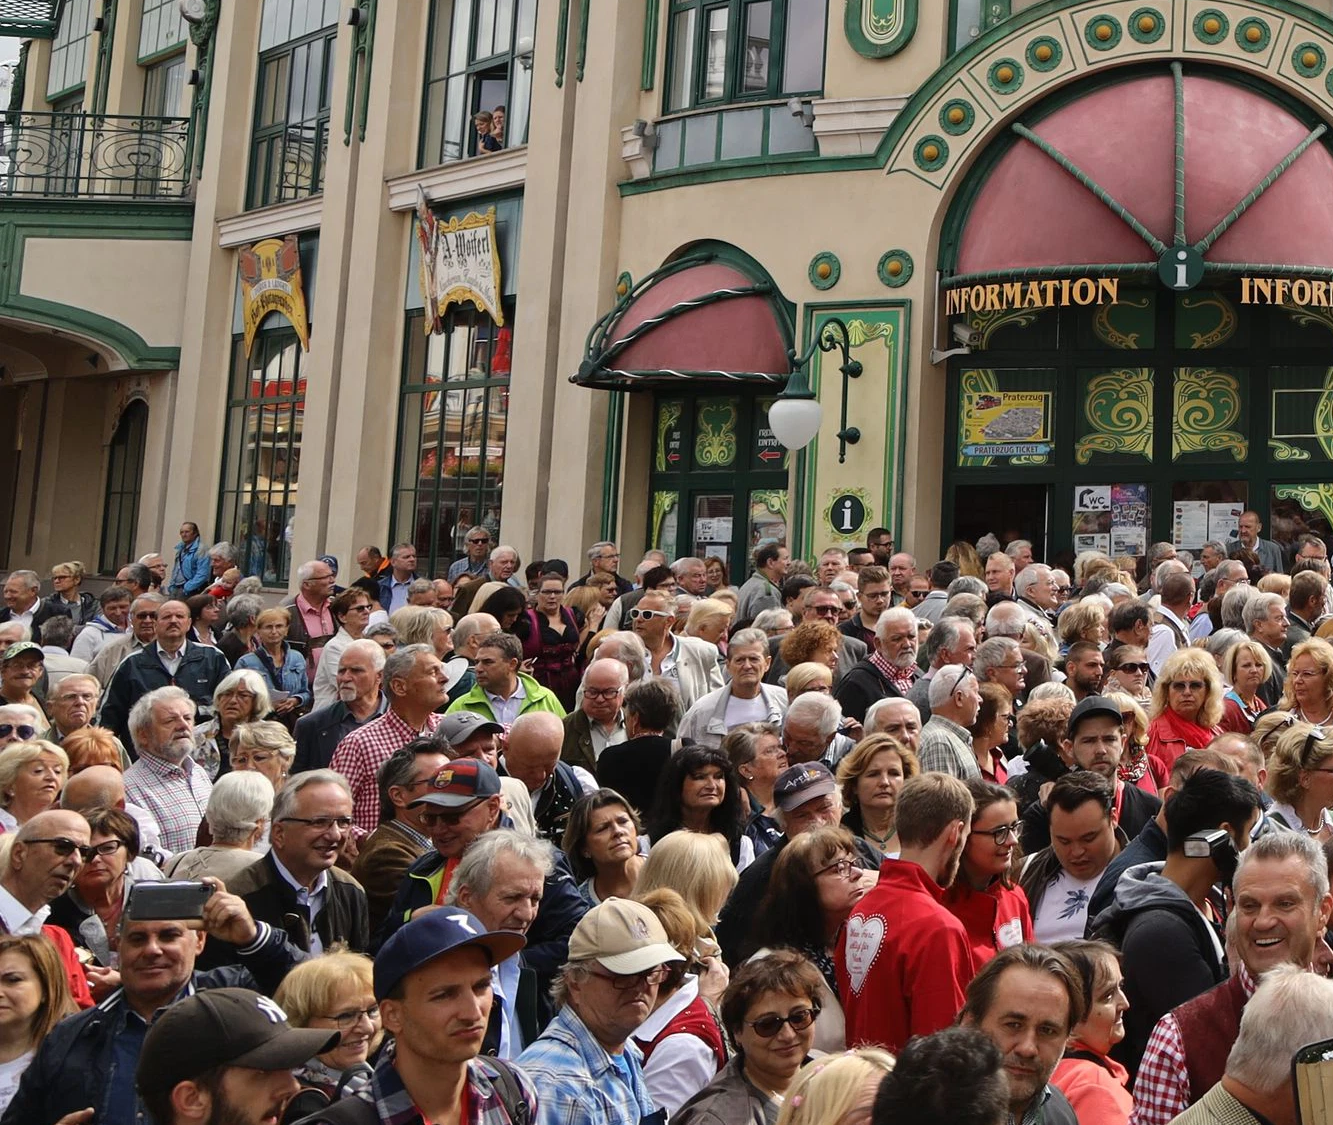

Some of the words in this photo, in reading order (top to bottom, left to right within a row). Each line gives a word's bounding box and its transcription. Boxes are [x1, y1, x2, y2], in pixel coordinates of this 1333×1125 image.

[945, 277, 1119, 316] INFORMATION
[1002, 393, 1044, 402] Praterzug
[974, 446, 1014, 454] PRATERZUG
[1015, 445, 1038, 453] TICKET
[1089, 496, 1105, 505] WC
